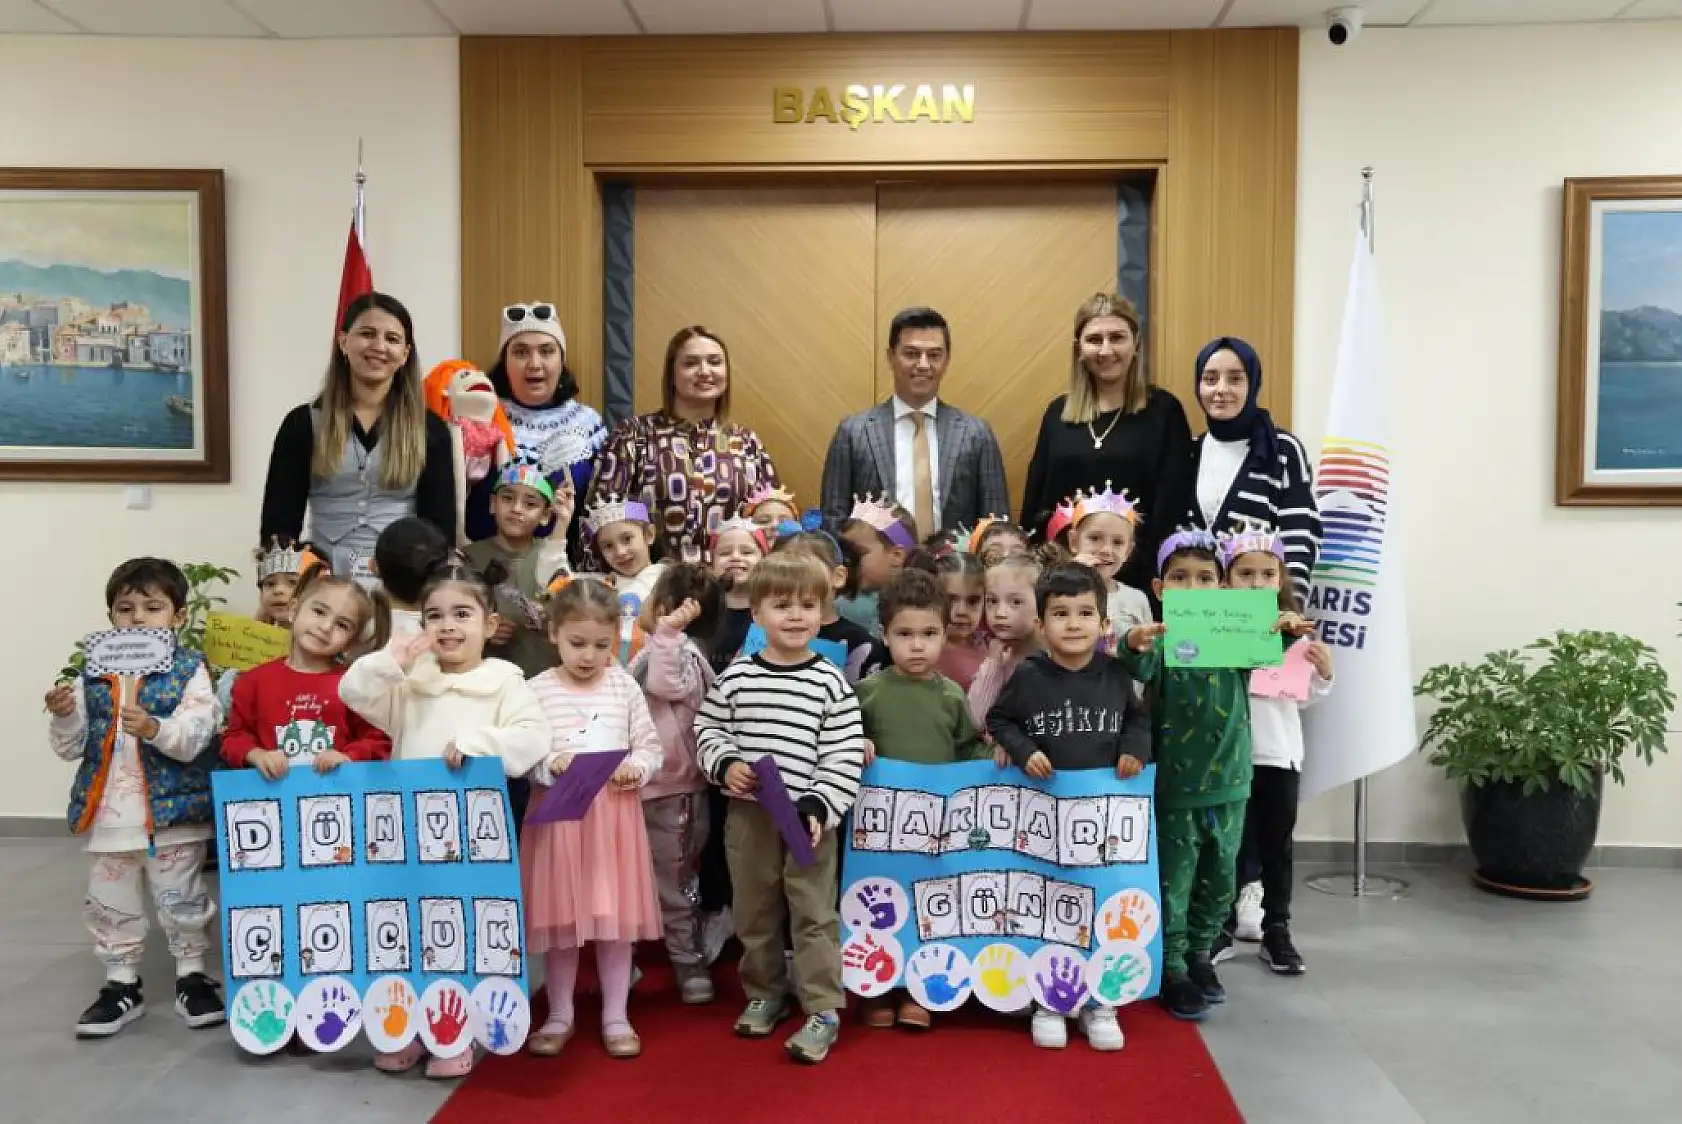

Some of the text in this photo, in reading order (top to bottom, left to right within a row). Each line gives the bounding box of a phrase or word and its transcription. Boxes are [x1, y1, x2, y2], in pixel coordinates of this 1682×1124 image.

[772, 84, 975, 131] BAŞKAN
[235, 811, 500, 852] DÜNYA
[863, 803, 1134, 846] HAKLARI
[927, 887, 1083, 928] GÜNÜ
[245, 920, 512, 963] ÇOCUK
